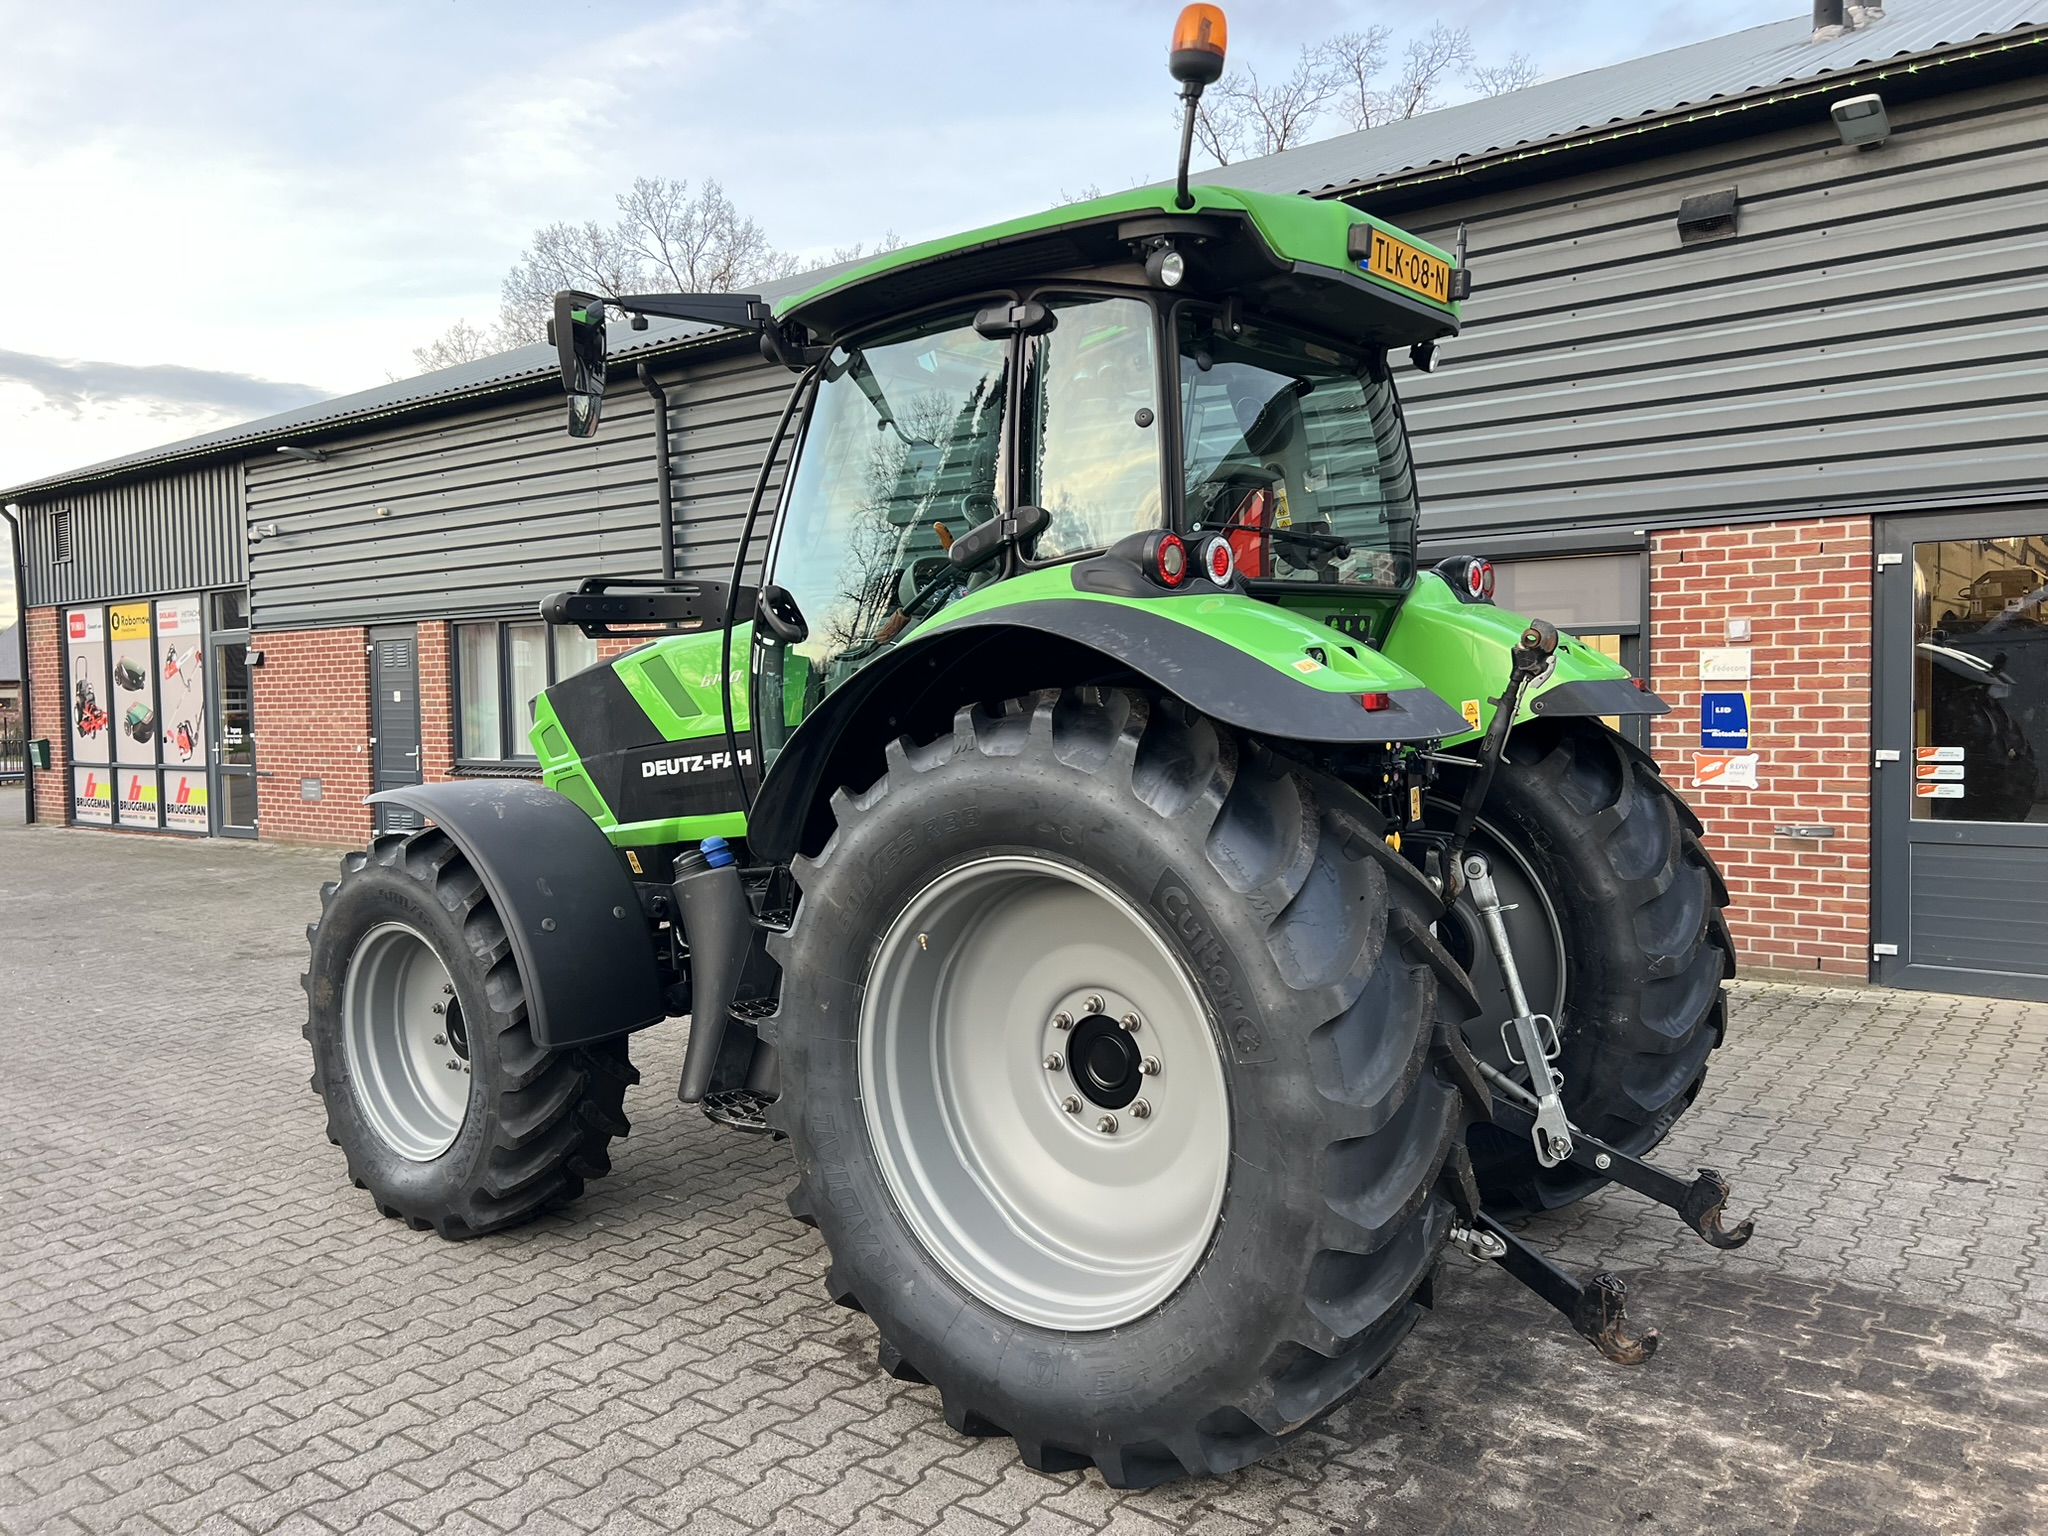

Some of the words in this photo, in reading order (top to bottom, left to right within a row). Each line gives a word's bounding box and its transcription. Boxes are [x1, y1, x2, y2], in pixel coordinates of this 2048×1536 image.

[1375, 237, 1446, 296] TLK-08-N
[700, 669, 744, 688] 610
[1714, 706, 1732, 714] LID
[1729, 762, 1750, 770] RDW
[76, 797, 110, 809] BRUGGEMAN
[120, 800, 156, 812] BRUGGEMAN
[166, 803, 206, 816] BRUGGEMAN
[1160, 886, 1244, 1010] Cultor
[811, 1112, 900, 1283] RADIAL
